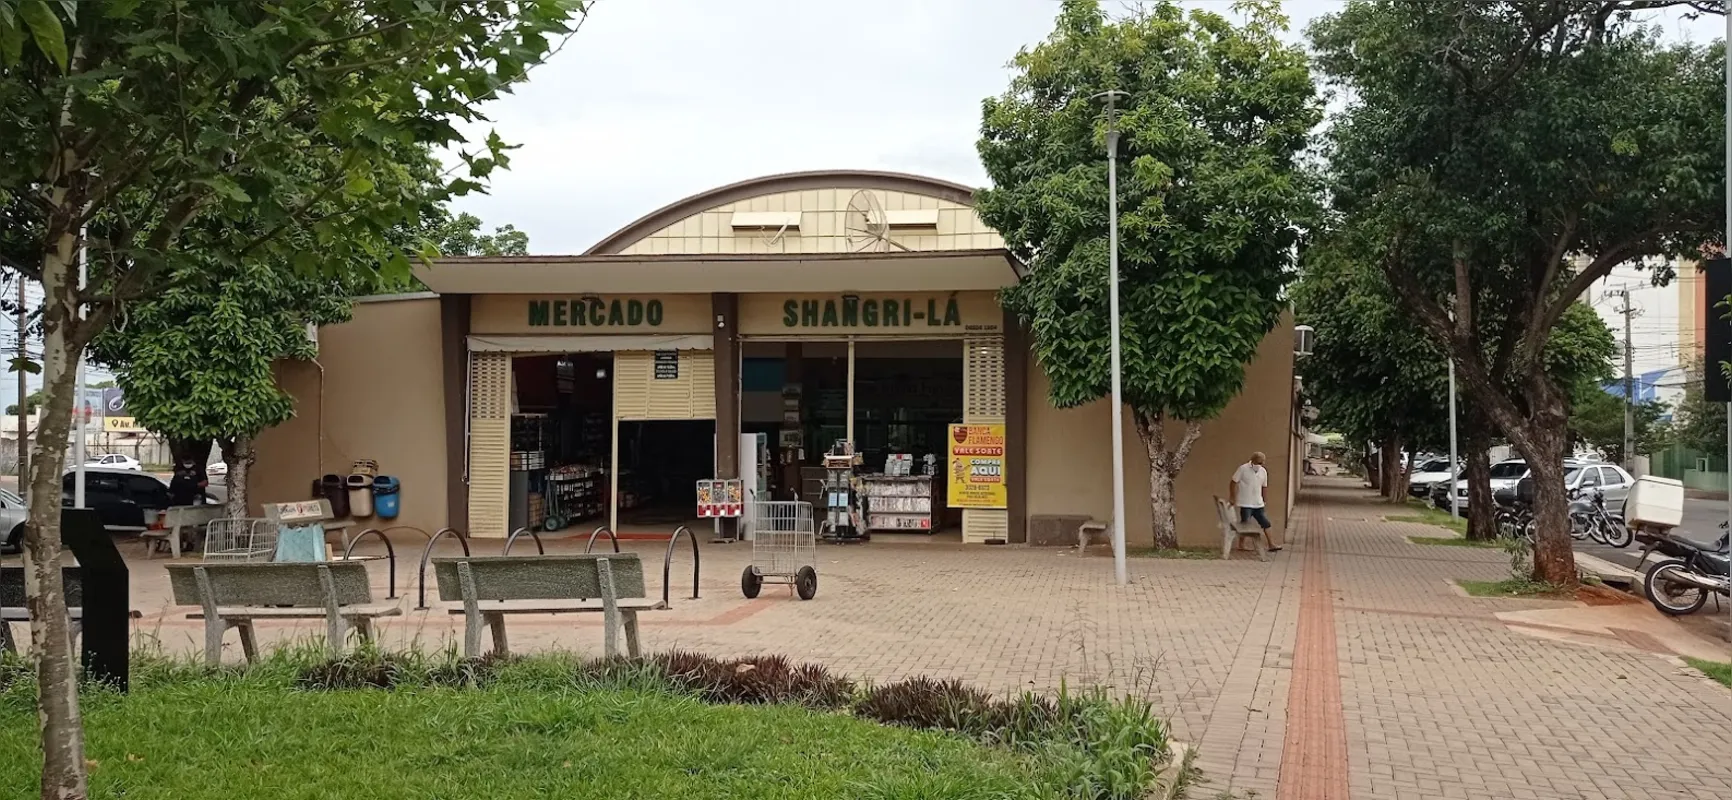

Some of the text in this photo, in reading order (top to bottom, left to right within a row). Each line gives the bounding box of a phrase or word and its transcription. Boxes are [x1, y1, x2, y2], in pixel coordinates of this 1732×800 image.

[528, 290, 961, 327] MERCADO SHANGRI-LÁ
[968, 436, 1003, 445] FLAMENGO
[954, 447, 1002, 455] VALE SORTE
[970, 466, 1001, 475] AQUI
